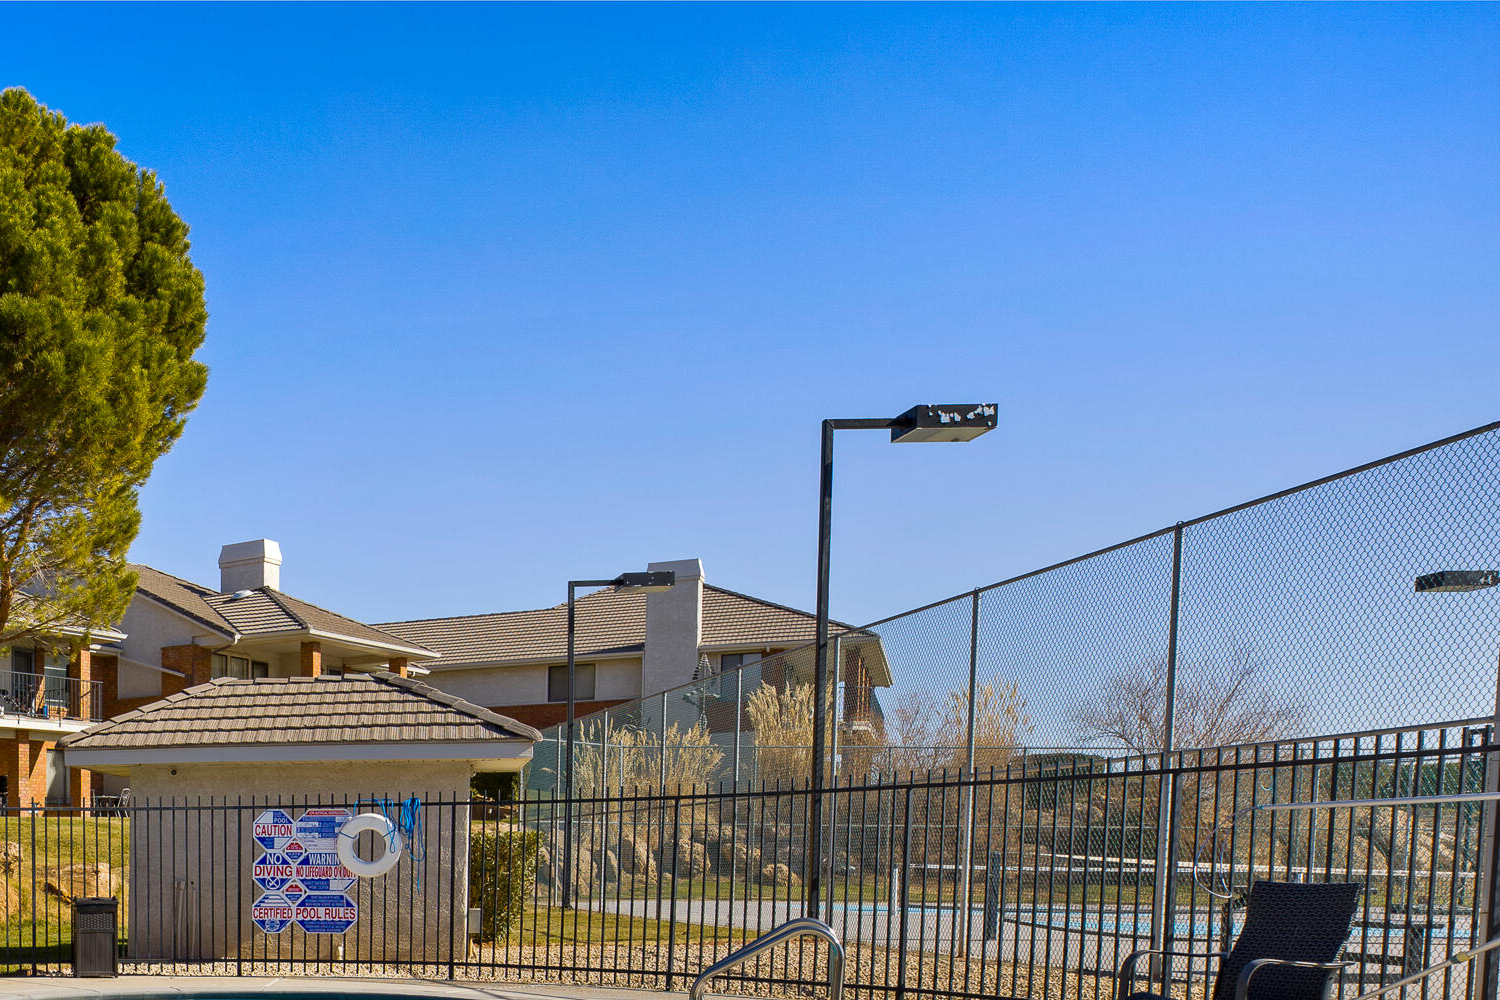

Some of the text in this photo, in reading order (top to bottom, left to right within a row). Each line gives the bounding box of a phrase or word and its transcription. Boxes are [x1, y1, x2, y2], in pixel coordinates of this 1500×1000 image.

[254, 824, 293, 836] CAUTION
[266, 853, 282, 865] NO
[308, 853, 341, 866] WARNIN
[254, 865, 293, 877] DIVING
[296, 866, 304, 877] NO
[305, 866, 333, 878] LIFEGUARD
[343, 866, 356, 878] DU
[253, 907, 293, 919] CERTIFIED
[295, 908, 356, 920] POOL RULES
